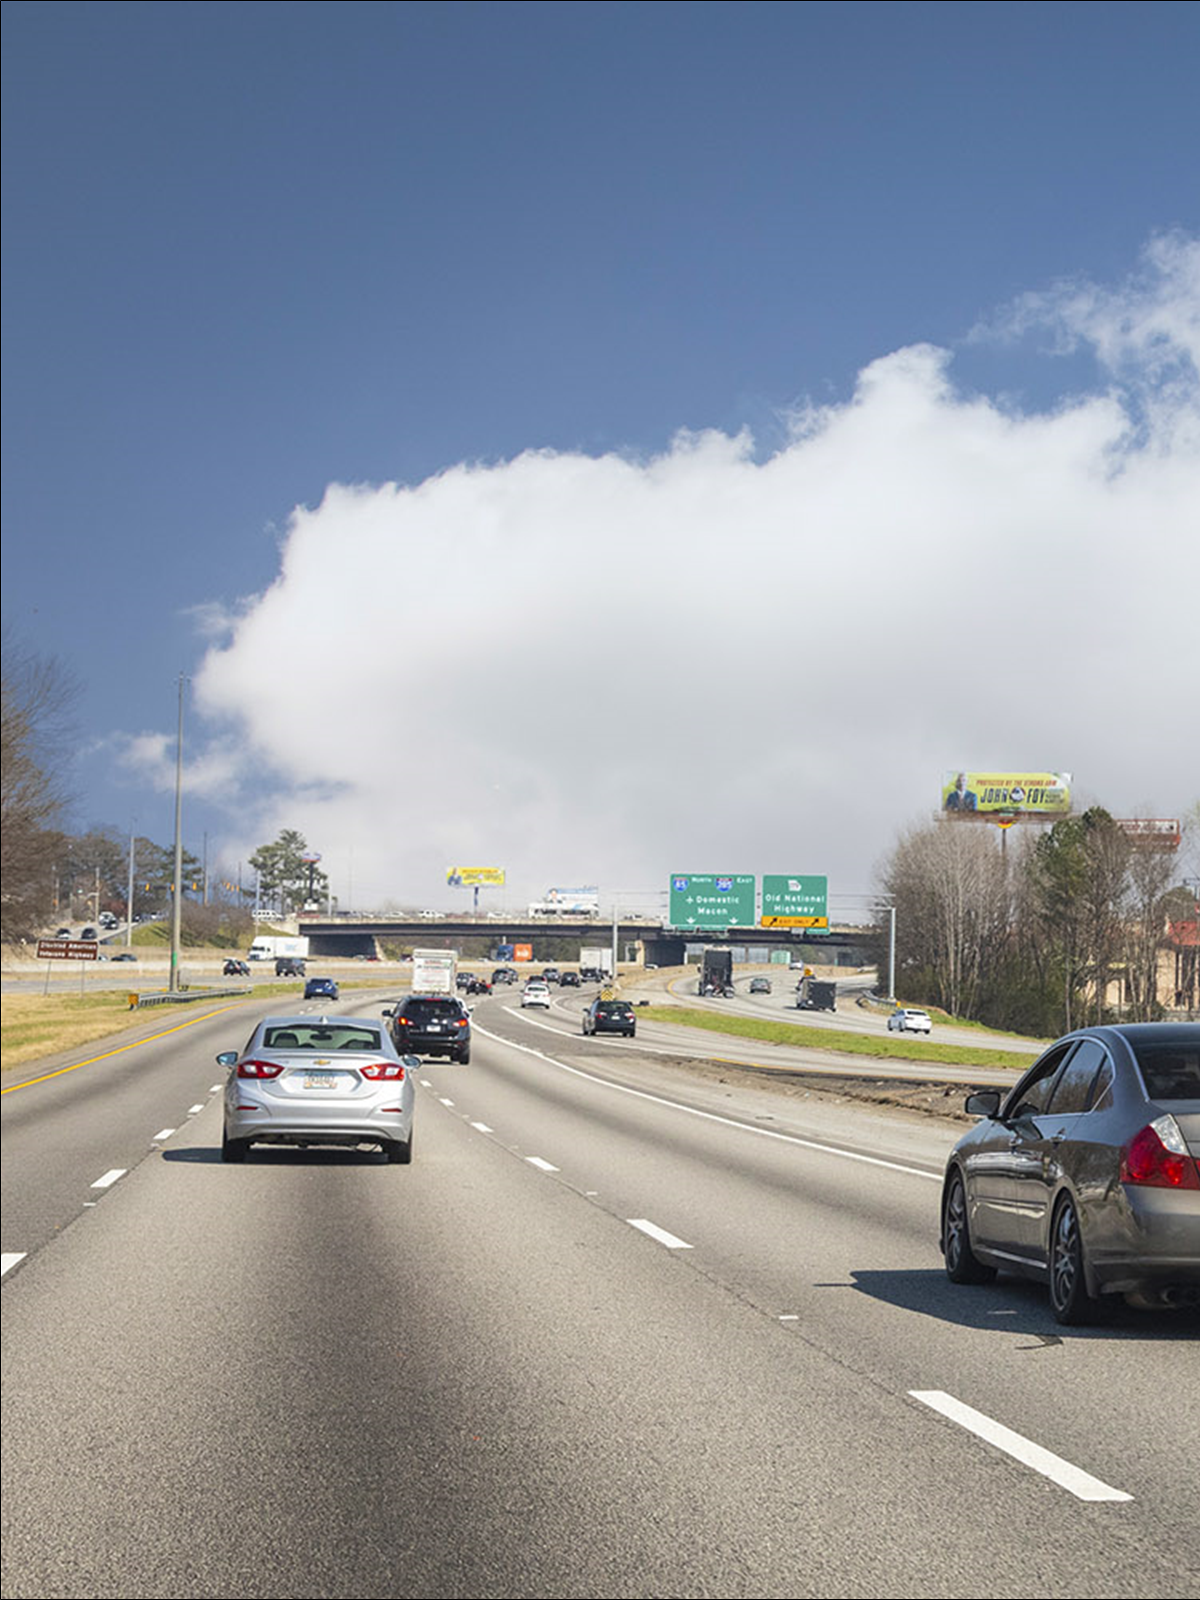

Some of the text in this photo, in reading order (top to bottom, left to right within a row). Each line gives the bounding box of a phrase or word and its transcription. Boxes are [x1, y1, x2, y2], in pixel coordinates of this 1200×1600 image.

[981, 788, 1009, 804] JOHN
[1026, 788, 1047, 804] FOY
[696, 895, 740, 904] Domestic
[765, 893, 825, 903] Old National
[697, 906, 729, 915] Macon
[774, 904, 815, 915] Highway
